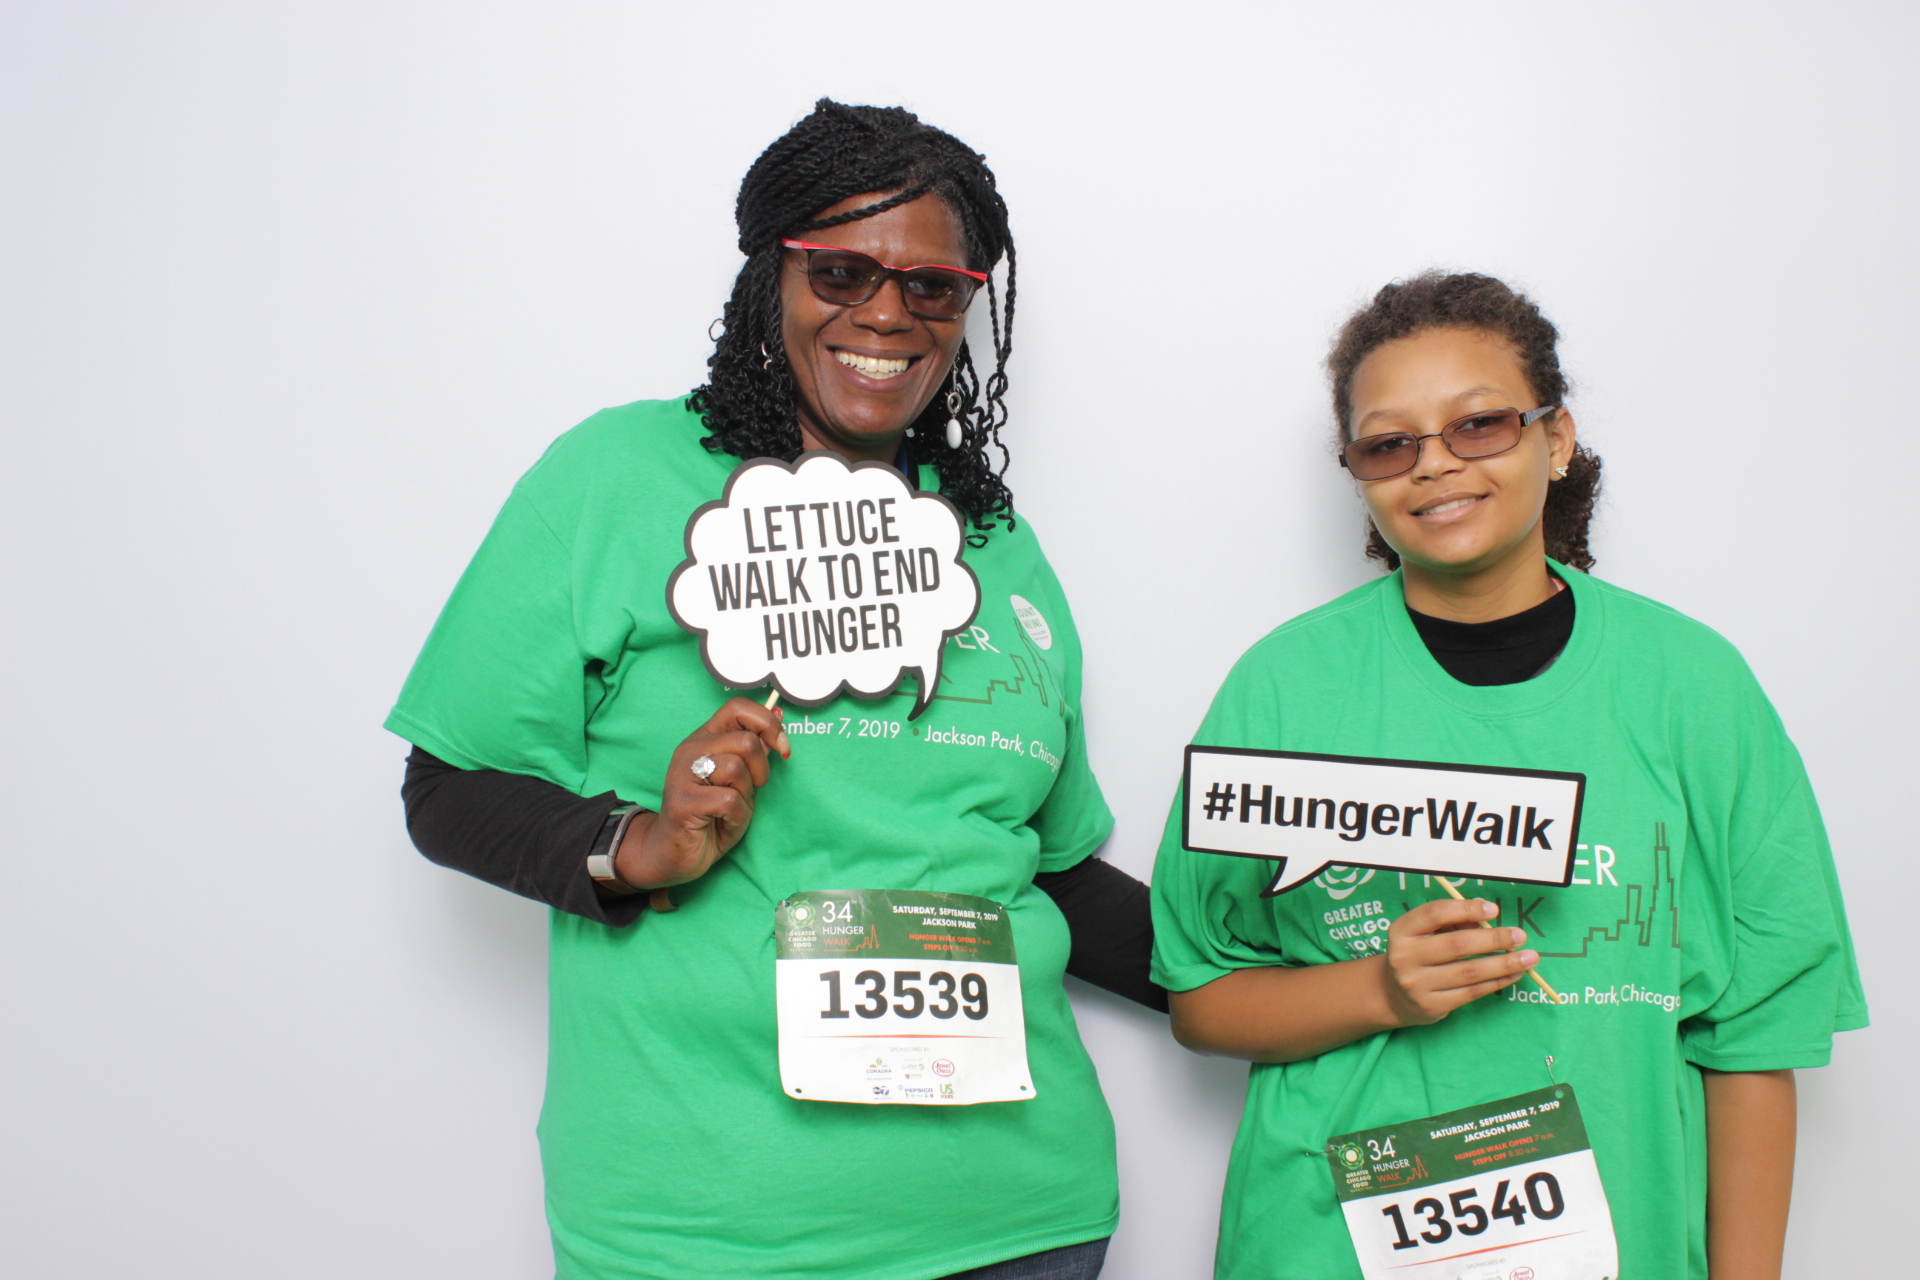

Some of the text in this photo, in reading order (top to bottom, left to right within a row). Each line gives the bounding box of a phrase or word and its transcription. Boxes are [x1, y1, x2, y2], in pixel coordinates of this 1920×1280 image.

[743, 497, 900, 554] LETTUCE
[708, 547, 941, 611] WALK TO END
[763, 602, 903, 661] HUNGER
[838, 717, 852, 739] 7,
[857, 719, 901, 739] 2019
[924, 725, 986, 747] Jackson
[991, 731, 1025, 756] Park,
[1203, 782, 1555, 850] #HungerWalk
[822, 901, 853, 923] 34
[892, 905, 937, 916] SATURDAY,
[939, 907, 976, 919] SEPTEMBER
[983, 913, 998, 921] 2019
[922, 917, 976, 929] JACKSON PARK
[1323, 900, 1384, 925] GREATER
[822, 926, 864, 935] HUNGER
[957, 936, 977, 944] OPENS
[823, 938, 851, 946] WALK
[923, 943, 941, 951] STEPS
[819, 969, 989, 1021] 13539
[1585, 985, 1620, 1006] Park,
[1430, 1122, 1477, 1139] SATURDAY,
[1479, 1109, 1528, 1127] SEPTEMBER
[1539, 1101, 1560, 1112] 2019
[1464, 1119, 1531, 1142] JACKSON PARK
[1367, 1136, 1396, 1161] 34
[1454, 1148, 1486, 1160] HUNGER
[1486, 1143, 1508, 1153] WALK
[1509, 1137, 1534, 1147] OPENS
[1472, 1156, 1493, 1166] STEPS
[1493, 1153, 1507, 1162] OFF
[1346, 1170, 1369, 1178] GREATER
[1373, 1159, 1410, 1173] HUNGER
[1376, 1172, 1401, 1182] WALK
[1346, 1176, 1371, 1184] CHICAGO
[1381, 1171, 1565, 1251] 13540
